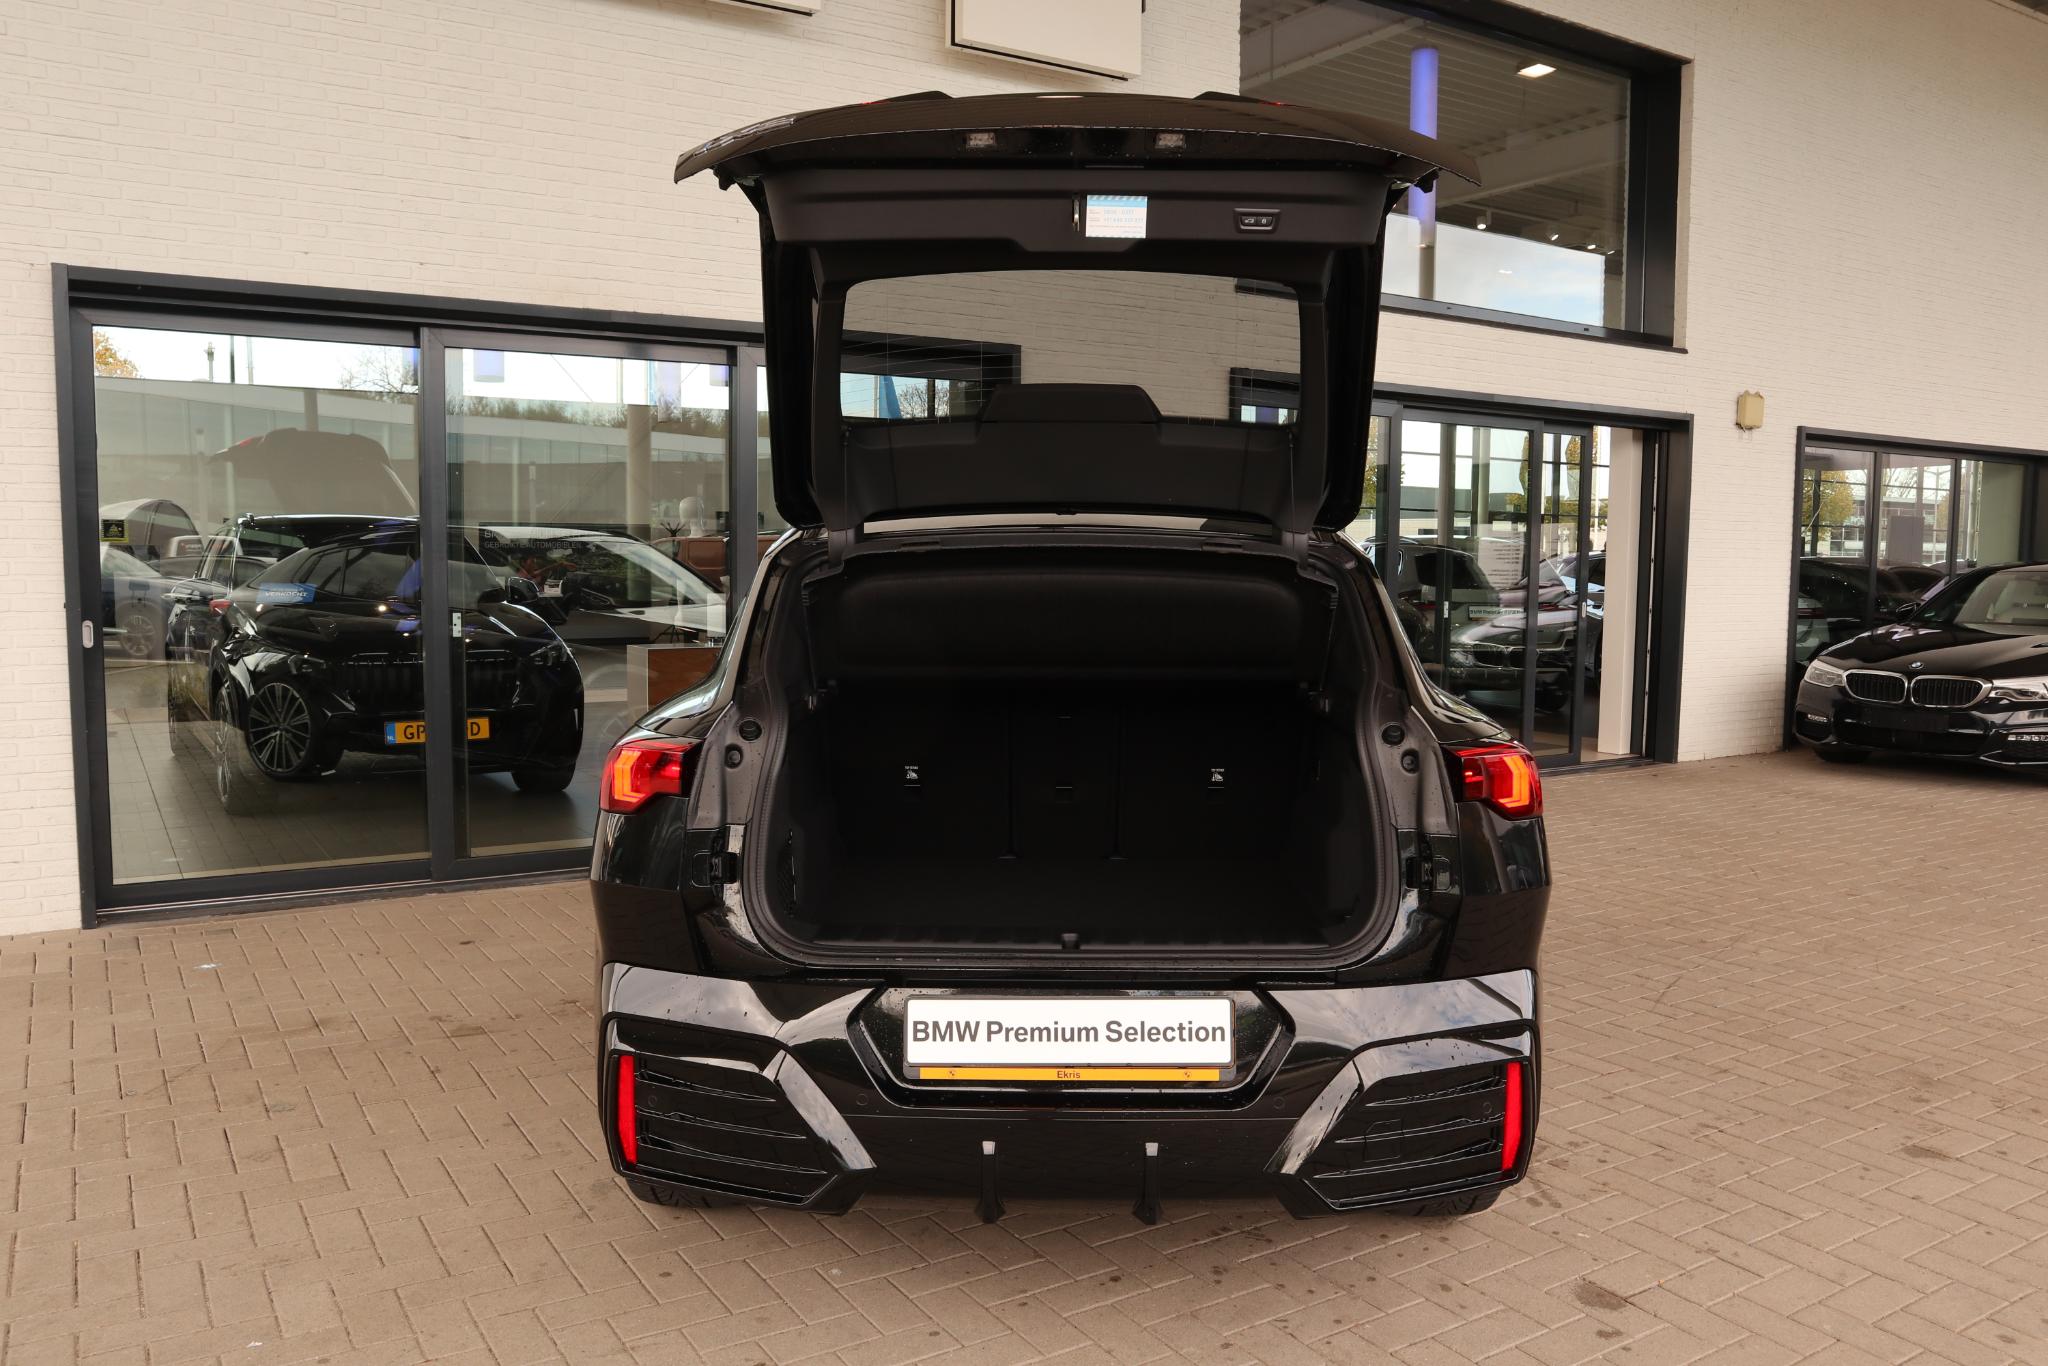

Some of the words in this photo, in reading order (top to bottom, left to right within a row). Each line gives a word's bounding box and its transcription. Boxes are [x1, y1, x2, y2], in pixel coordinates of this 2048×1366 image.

[912, 1021, 980, 1042] BMW
[986, 1021, 1099, 1042] Premium
[1105, 1020, 1226, 1042] Selection
[1056, 1070, 1081, 1079] Ekris
